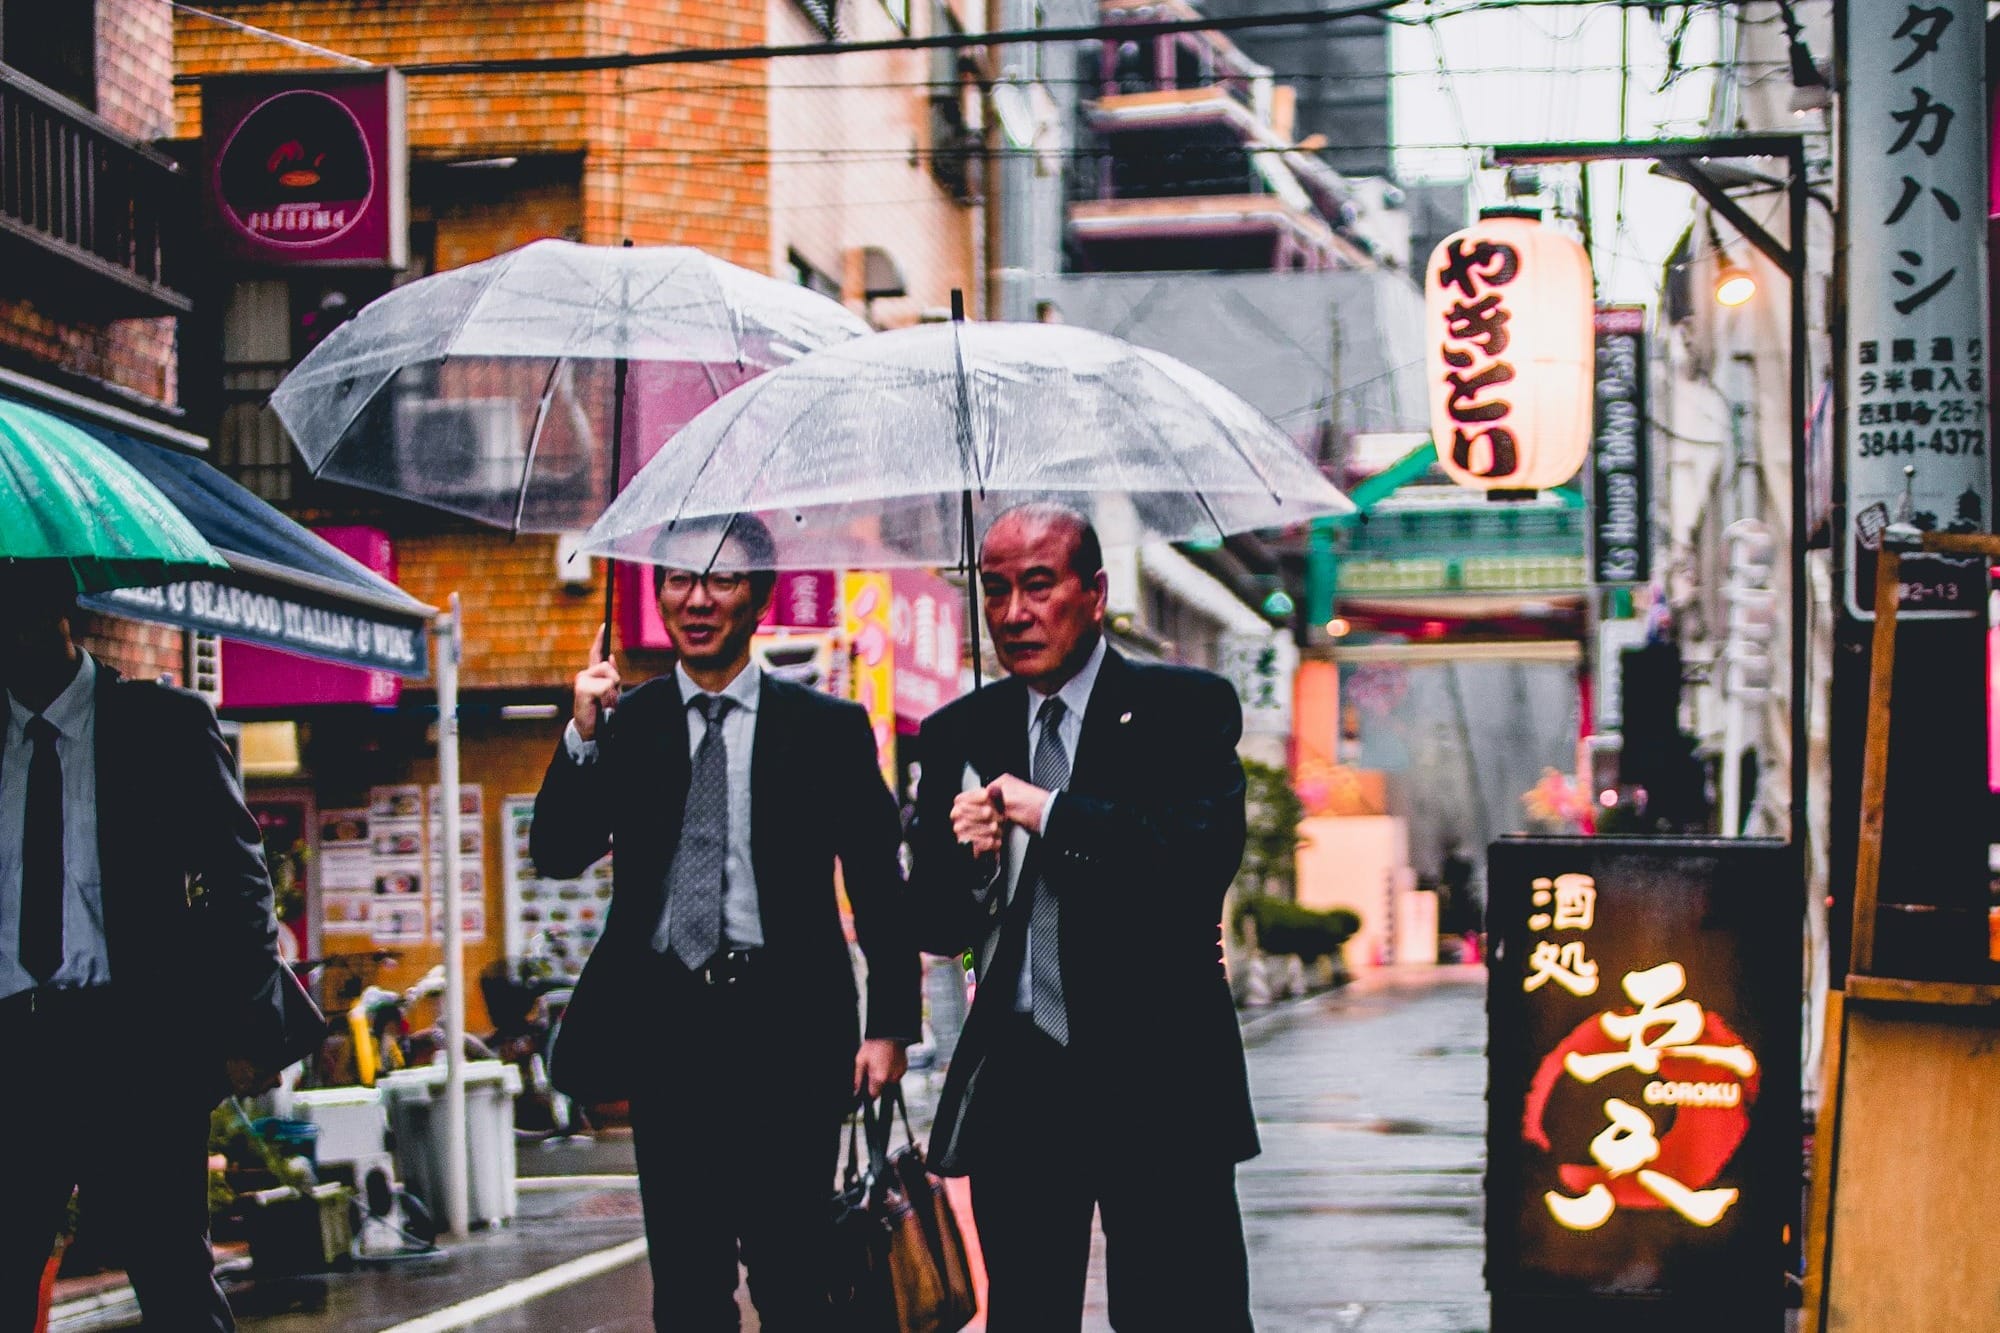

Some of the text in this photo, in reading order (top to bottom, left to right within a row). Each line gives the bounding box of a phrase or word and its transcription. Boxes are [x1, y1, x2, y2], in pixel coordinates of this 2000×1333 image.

[1883, 4, 1961, 315] タカハシ
[1439, 238, 1520, 478] やきとり
[1597, 401, 1639, 471] Tokyo
[1859, 428, 1985, 457] 3844-4372
[1599, 472, 1638, 545] House
[190, 580, 282, 634] SEAFOOD
[284, 600, 355, 650] ITALIAN
[357, 618, 372, 657] &
[373, 621, 416, 664] WINE
[1522, 871, 1600, 997] 酒処
[1643, 1080, 1742, 1107] GOROKU
